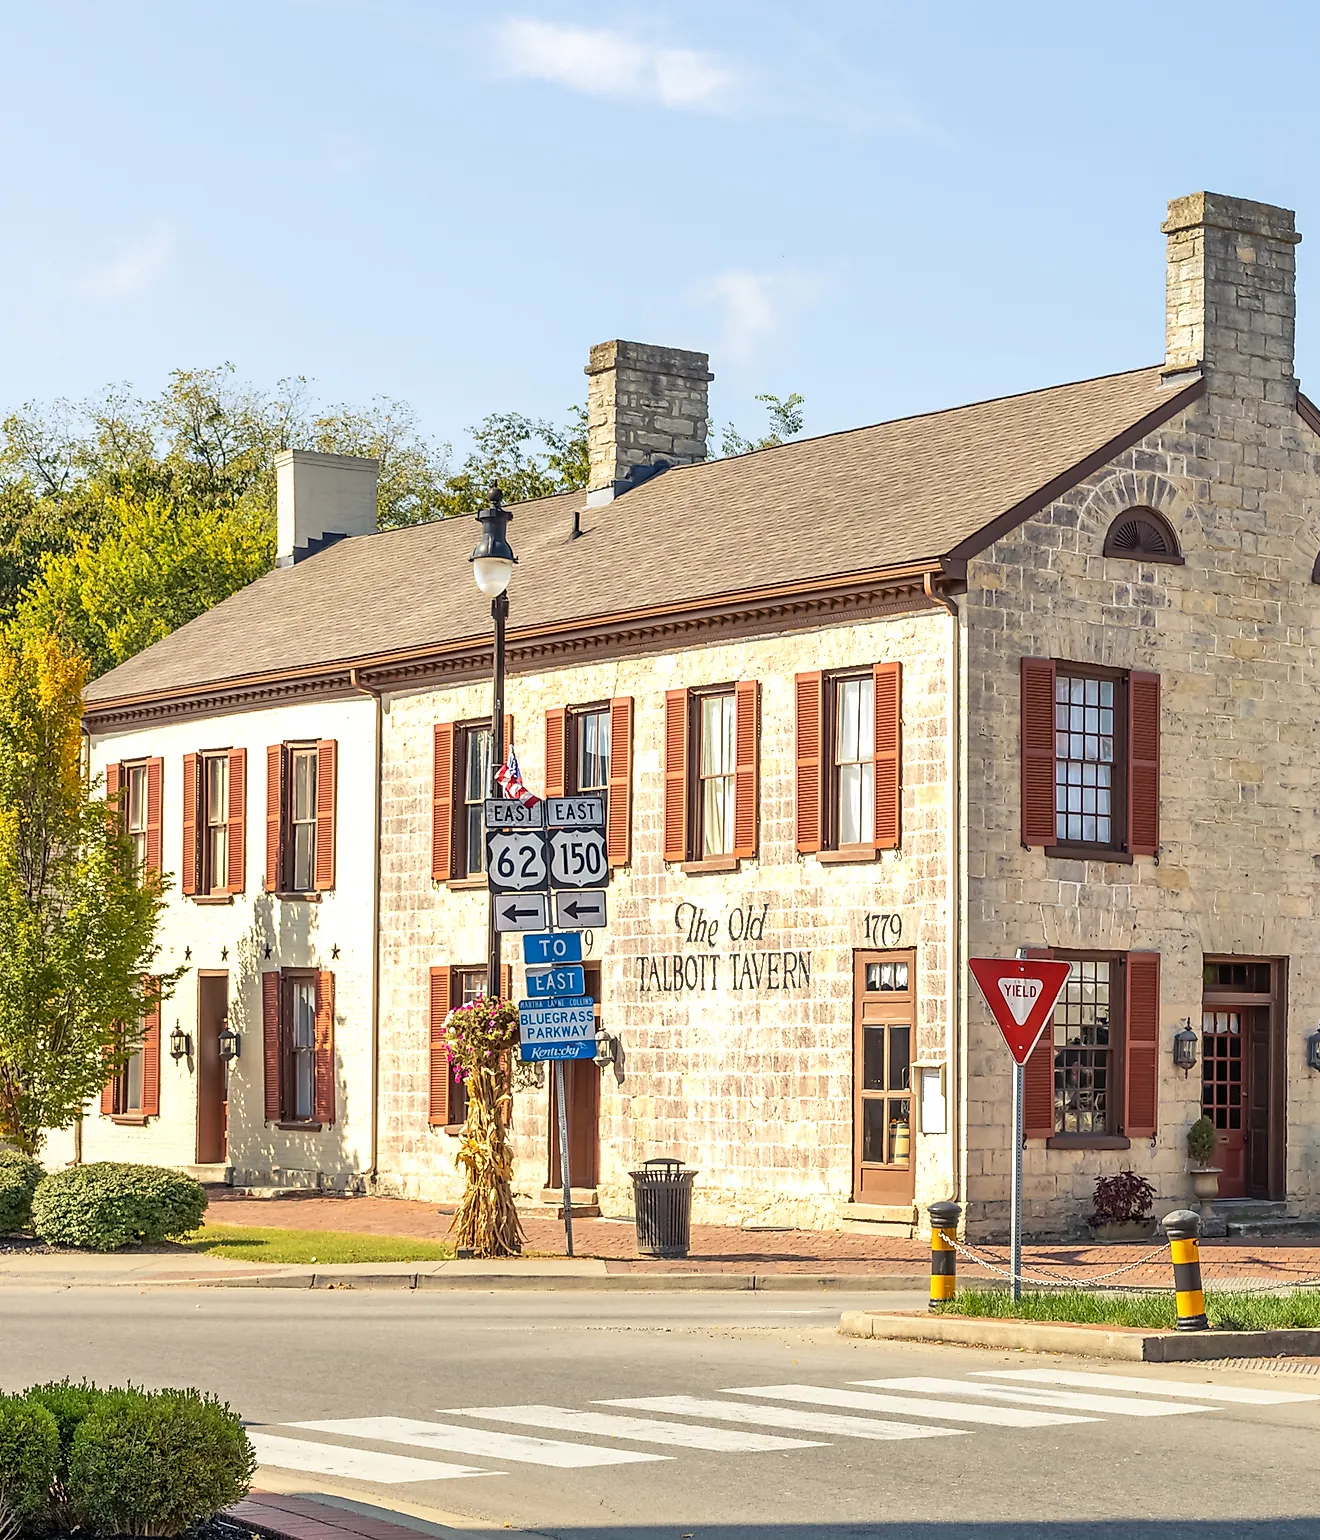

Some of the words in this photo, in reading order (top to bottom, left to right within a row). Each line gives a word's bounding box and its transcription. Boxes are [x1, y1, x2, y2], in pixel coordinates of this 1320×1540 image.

[494, 805, 533, 822] EAST
[555, 803, 595, 820] EAST
[497, 845, 539, 878] 62
[560, 842, 601, 875] 150
[675, 902, 719, 948] The
[728, 903, 770, 941] Old
[864, 911, 902, 947] 1779
[538, 939, 567, 957] TO
[636, 954, 721, 992] TALBOTT
[729, 950, 812, 991] TAVERN
[535, 972, 575, 991] EAST
[1004, 984, 1037, 998] YIELD
[520, 1000, 544, 1009] MARTHA
[569, 997, 593, 1006] COLLINS
[520, 1010, 594, 1026] BLUEGRASS
[527, 1025, 588, 1040] PARKWAY
[531, 1045, 580, 1060] Kentucky
